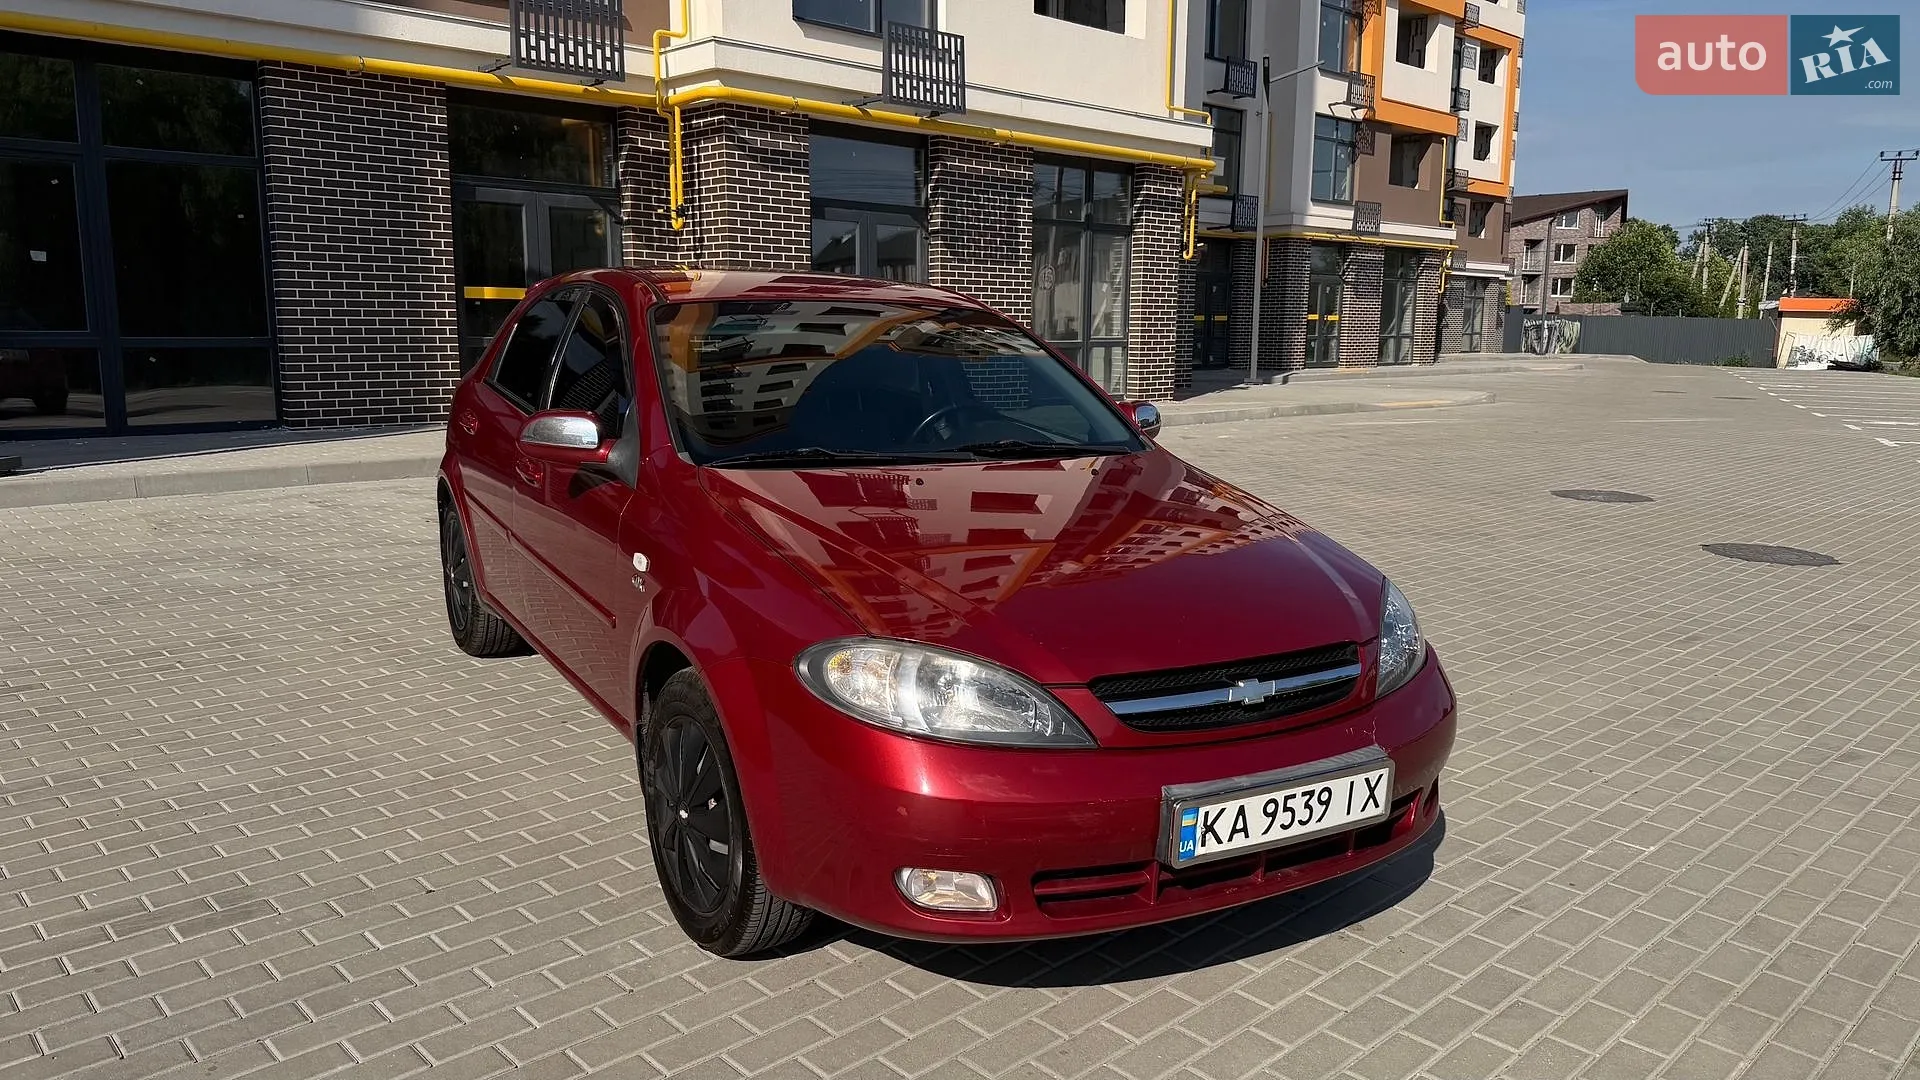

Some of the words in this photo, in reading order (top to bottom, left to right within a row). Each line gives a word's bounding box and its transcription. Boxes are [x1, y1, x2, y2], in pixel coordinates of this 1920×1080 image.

[1200, 804, 1250, 847] KA
[1261, 786, 1333, 835] 9539
[1179, 839, 1195, 852] UA
